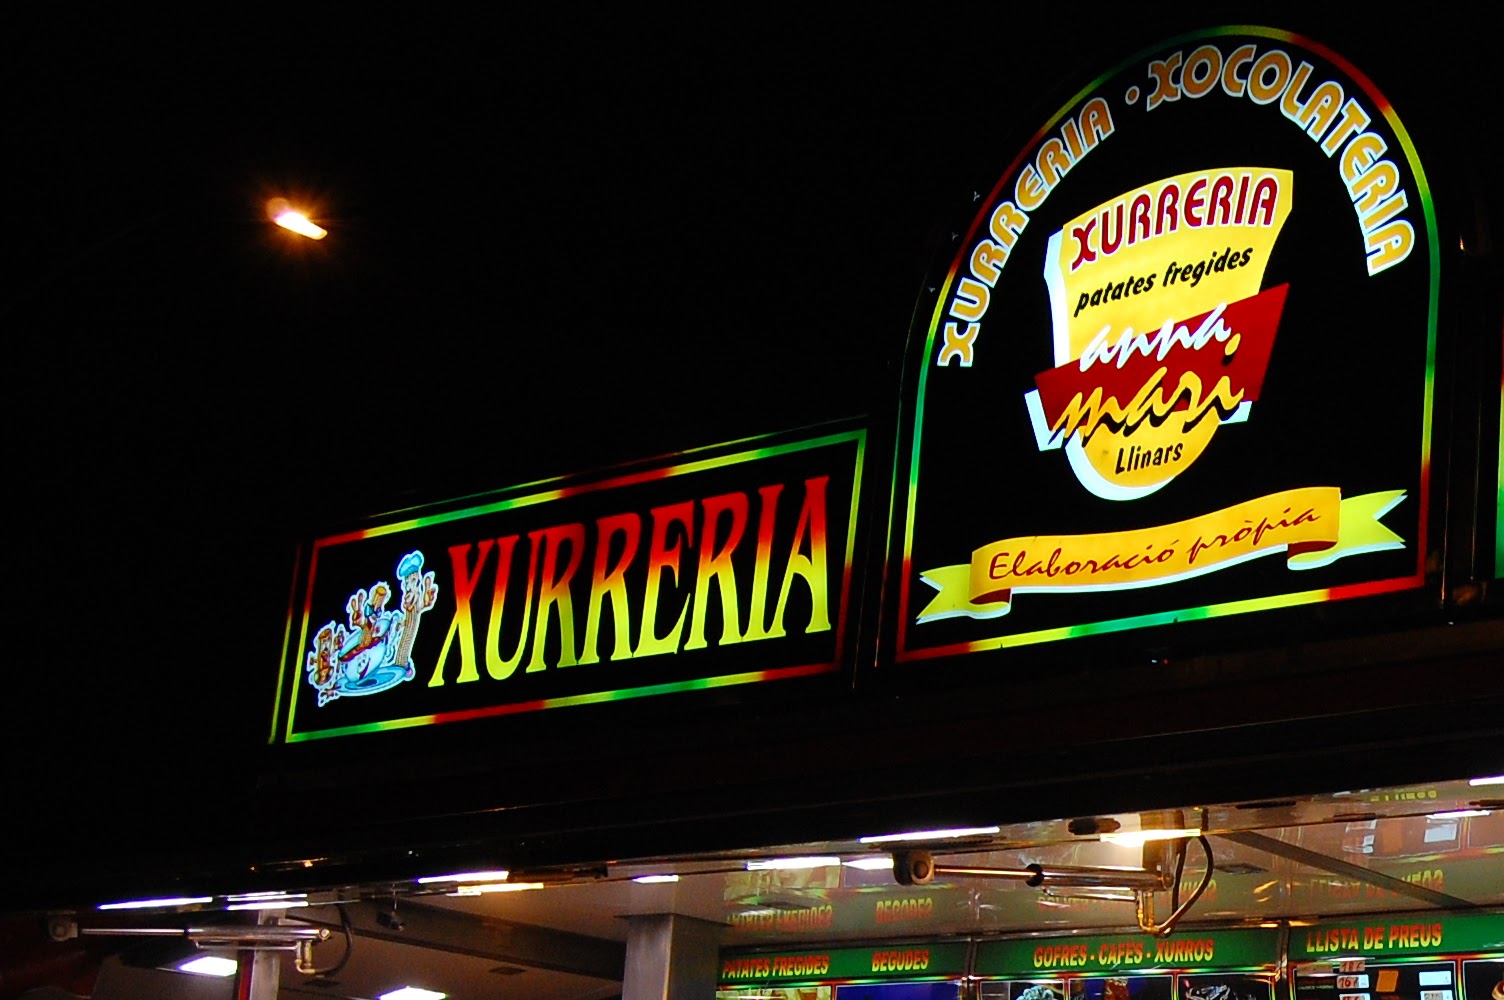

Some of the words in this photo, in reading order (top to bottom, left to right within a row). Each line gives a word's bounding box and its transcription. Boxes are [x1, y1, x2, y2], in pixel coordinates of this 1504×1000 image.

[937, 97, 1115, 367] XURRERIA
[1147, 44, 1415, 276] XOCOLATERIA
[1071, 172, 1280, 272] XURRERIA
[1074, 275, 1156, 317] patates
[1162, 246, 1254, 290] fregides
[1115, 441, 1184, 475] Llinars
[989, 538, 1179, 580] Elaboració
[1184, 505, 1321, 562] pròpia
[428, 475, 832, 690] XURRERIA
[871, 949, 930, 973] BEGUDES
[1033, 943, 1088, 969] GOFRES
[1154, 938, 1215, 965] XURROS
[1306, 928, 1359, 953] LLISTA
[1363, 927, 1384, 949] DE
[1388, 923, 1442, 948] PREUS
[722, 956, 770, 980] PATATES
[772, 954, 830, 977] FREGIDES
